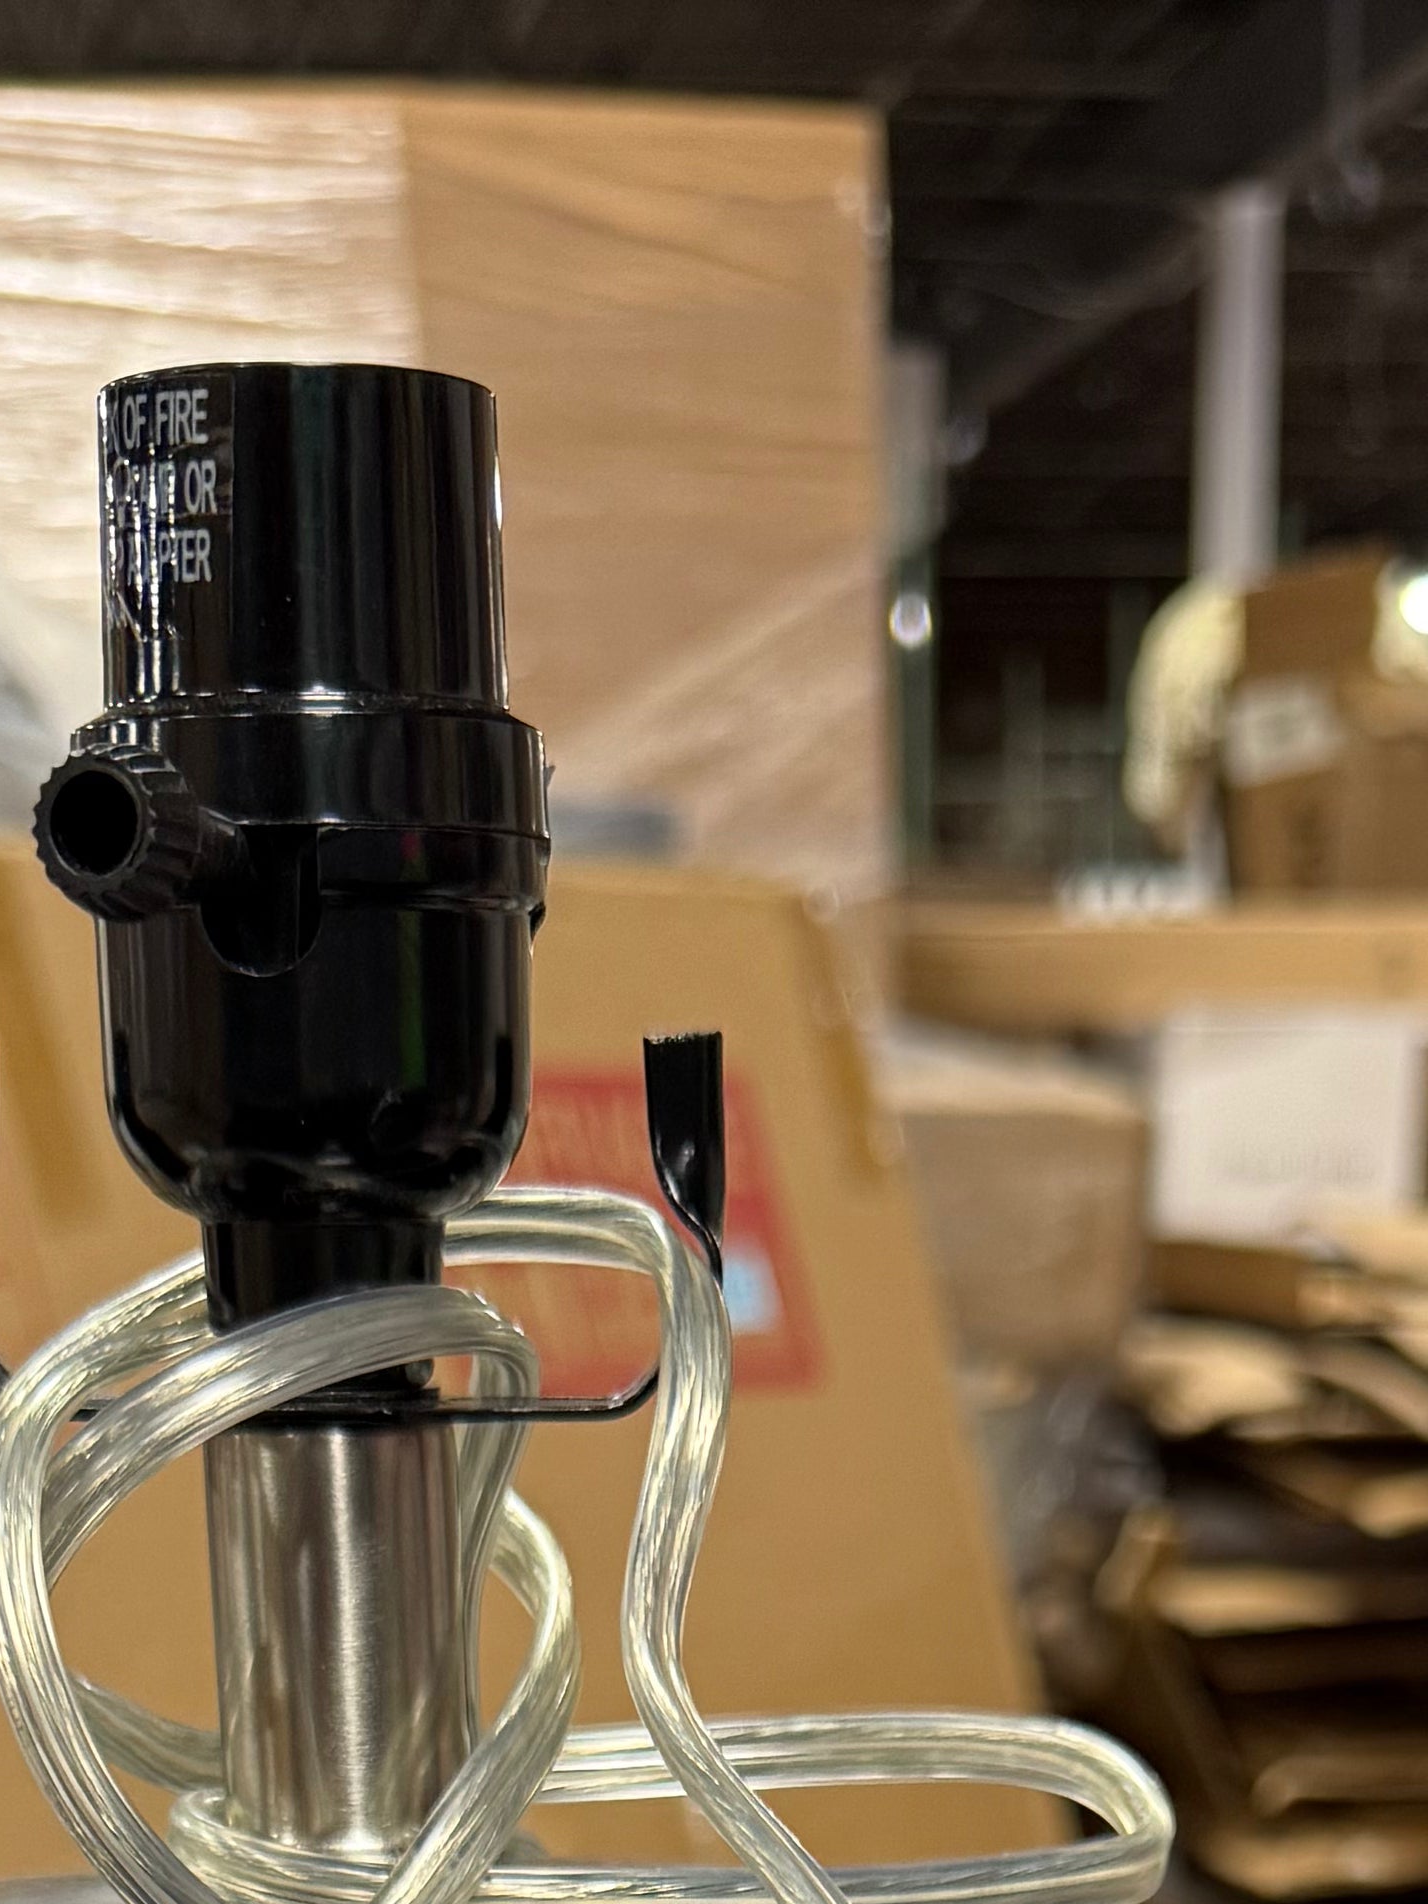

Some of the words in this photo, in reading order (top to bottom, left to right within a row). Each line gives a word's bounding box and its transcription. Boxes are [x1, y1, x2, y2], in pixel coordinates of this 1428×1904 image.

[122, 394, 148, 450] OF
[154, 387, 209, 446] FIRE
[183, 457, 218, 515] OR
[127, 528, 212, 587] ADPTER
